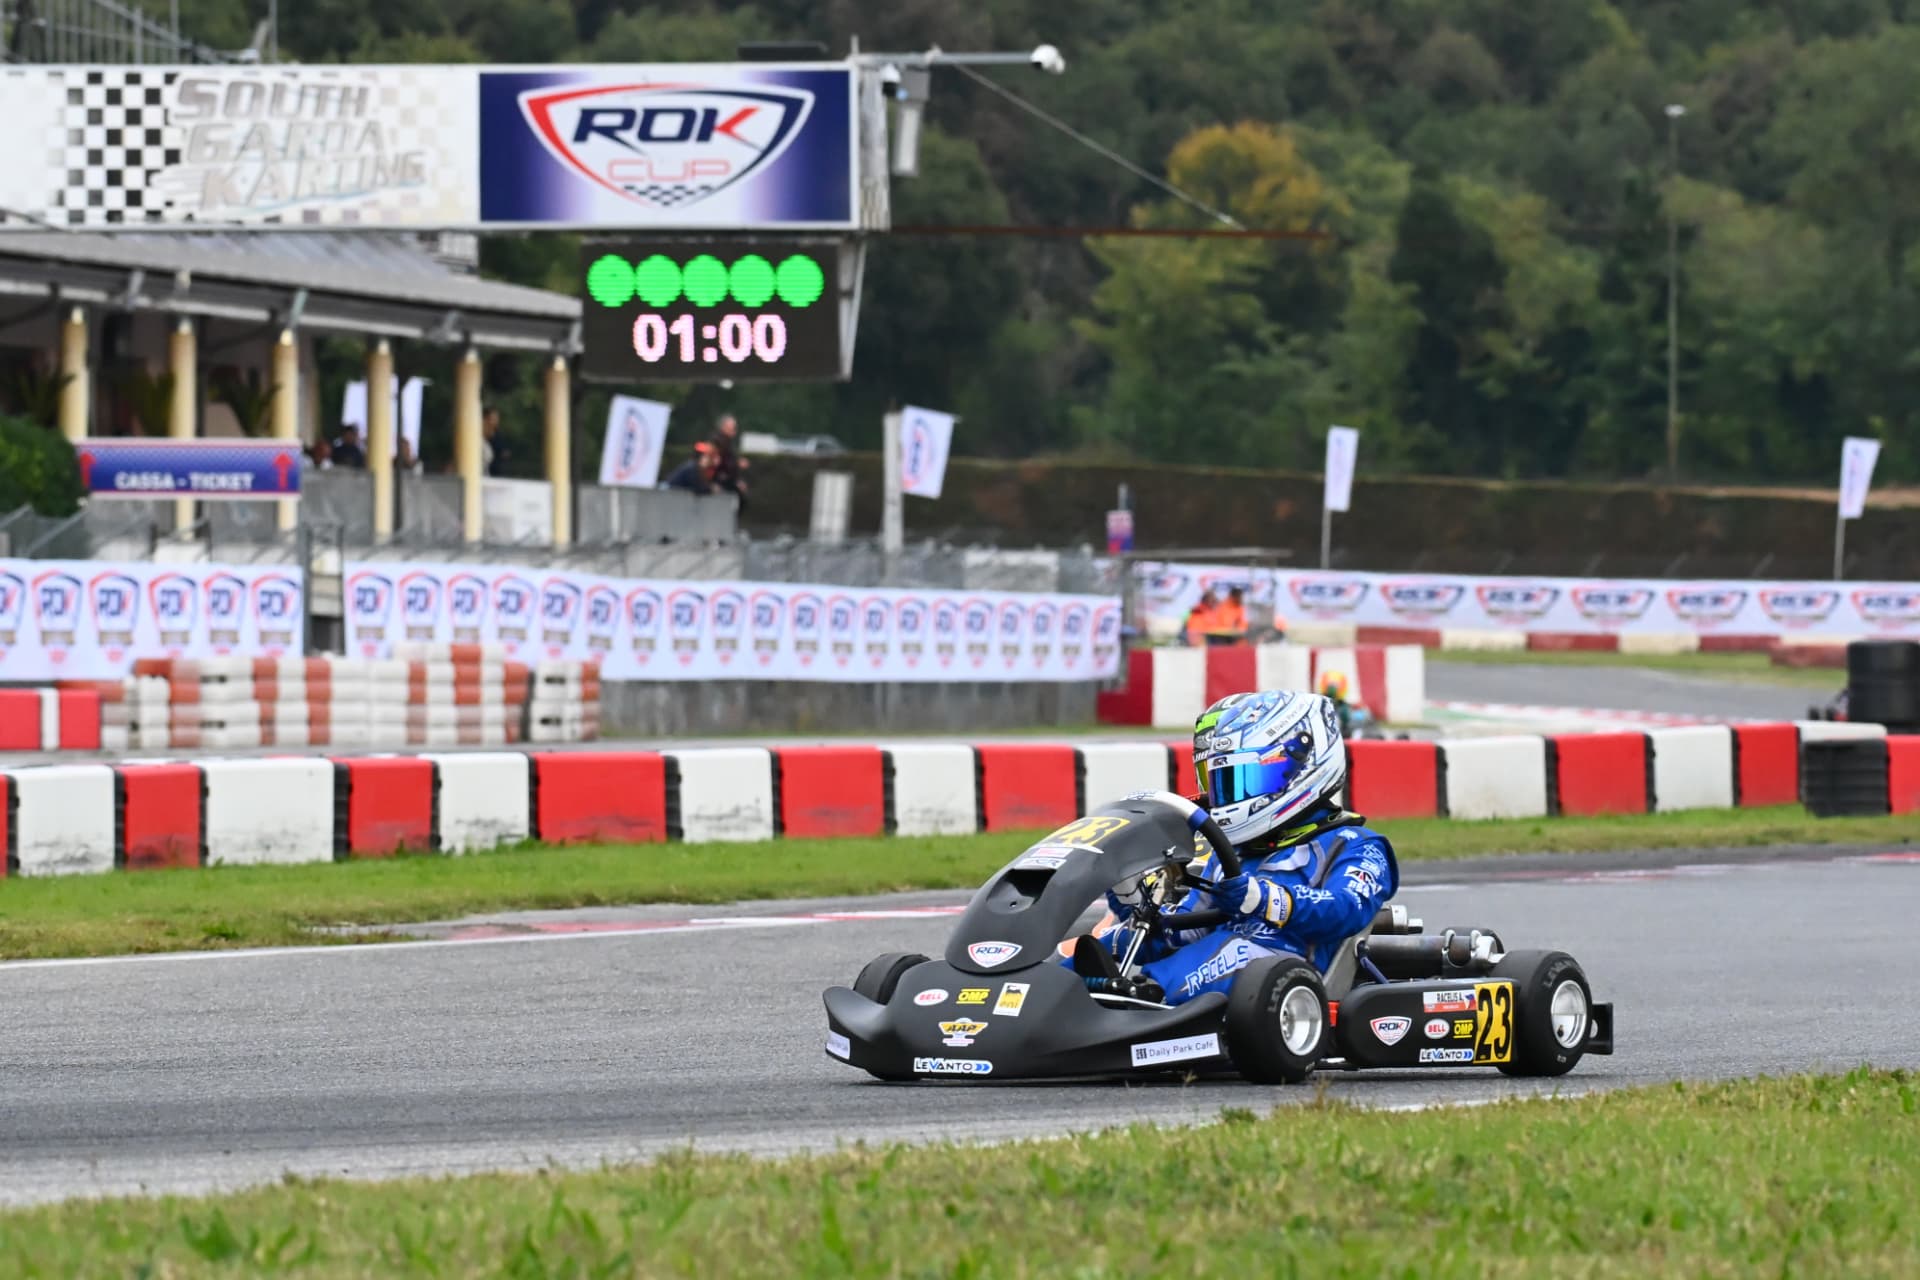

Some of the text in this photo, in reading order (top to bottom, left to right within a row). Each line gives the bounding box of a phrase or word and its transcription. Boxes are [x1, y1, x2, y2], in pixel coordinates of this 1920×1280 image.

[174, 79, 370, 119] SOUTH
[573, 106, 762, 154] ROK
[606, 159, 732, 181] CUP
[200, 151, 425, 206] KARTING
[632, 314, 787, 363] 01:00
[114, 471, 175, 490] CASSA
[975, 946, 1010, 955] ROK
[920, 993, 941, 1001] BELL
[958, 991, 989, 1001] OMP
[1379, 1022, 1404, 1031] ROK
[1428, 1024, 1445, 1033] BELL
[1454, 1023, 1474, 1035] OMP
[1477, 985, 1513, 1060] 23
[1148, 1046, 1171, 1059] Daily
[1172, 1044, 1193, 1054] Park
[1421, 1048, 1462, 1060] LEVANTO
[915, 1060, 973, 1071] LEVANTO
